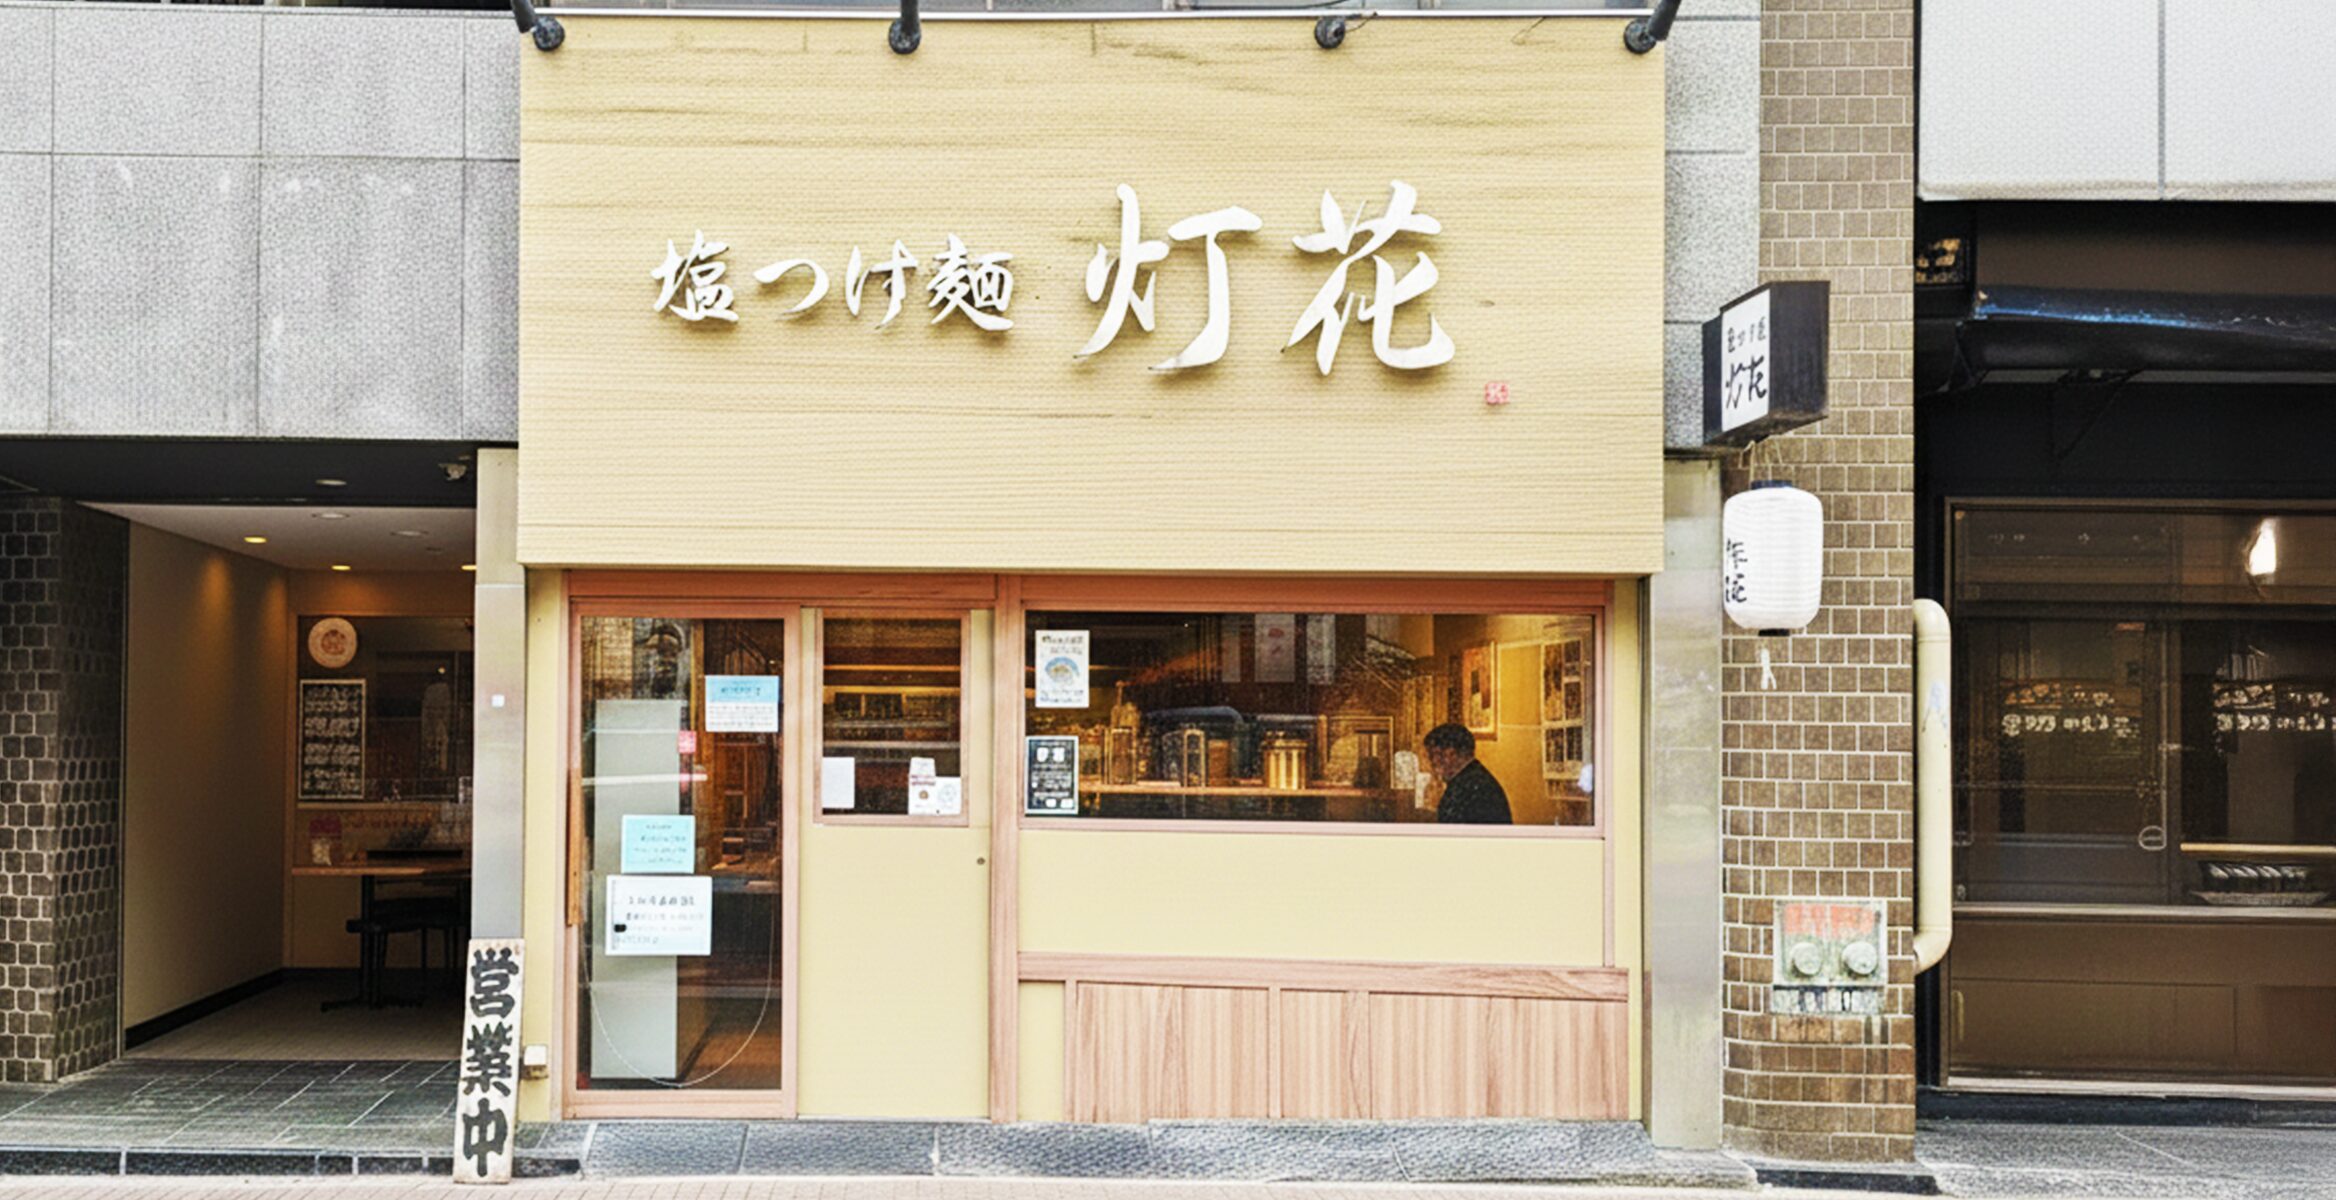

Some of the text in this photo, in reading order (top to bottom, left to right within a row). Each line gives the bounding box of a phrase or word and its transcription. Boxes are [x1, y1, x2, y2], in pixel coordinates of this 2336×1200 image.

[651, 179, 1456, 376] 塩つけ麺 灯花
[462, 947, 519, 1177] 営業中
